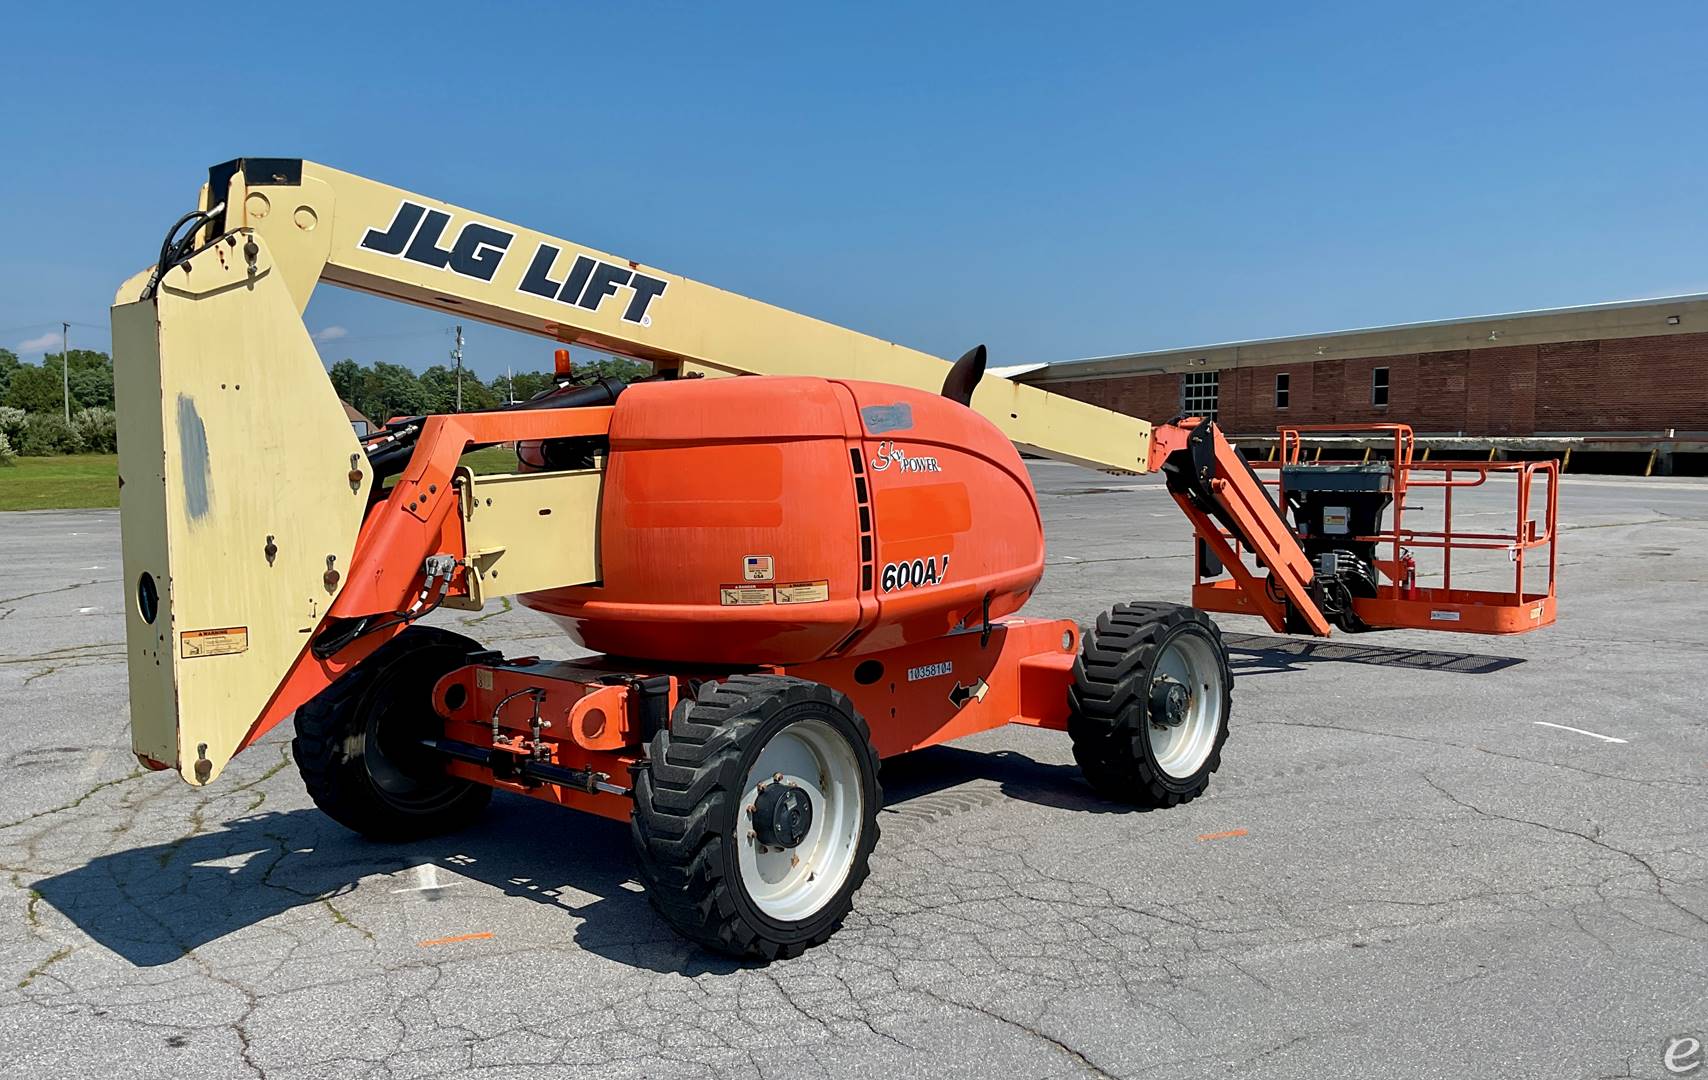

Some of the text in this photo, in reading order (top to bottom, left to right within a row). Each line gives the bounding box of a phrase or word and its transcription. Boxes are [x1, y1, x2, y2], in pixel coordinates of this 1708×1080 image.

[360, 201, 668, 324] JLG LIFT
[902, 457, 939, 472] POWER
[908, 661, 951, 680] 10358104
